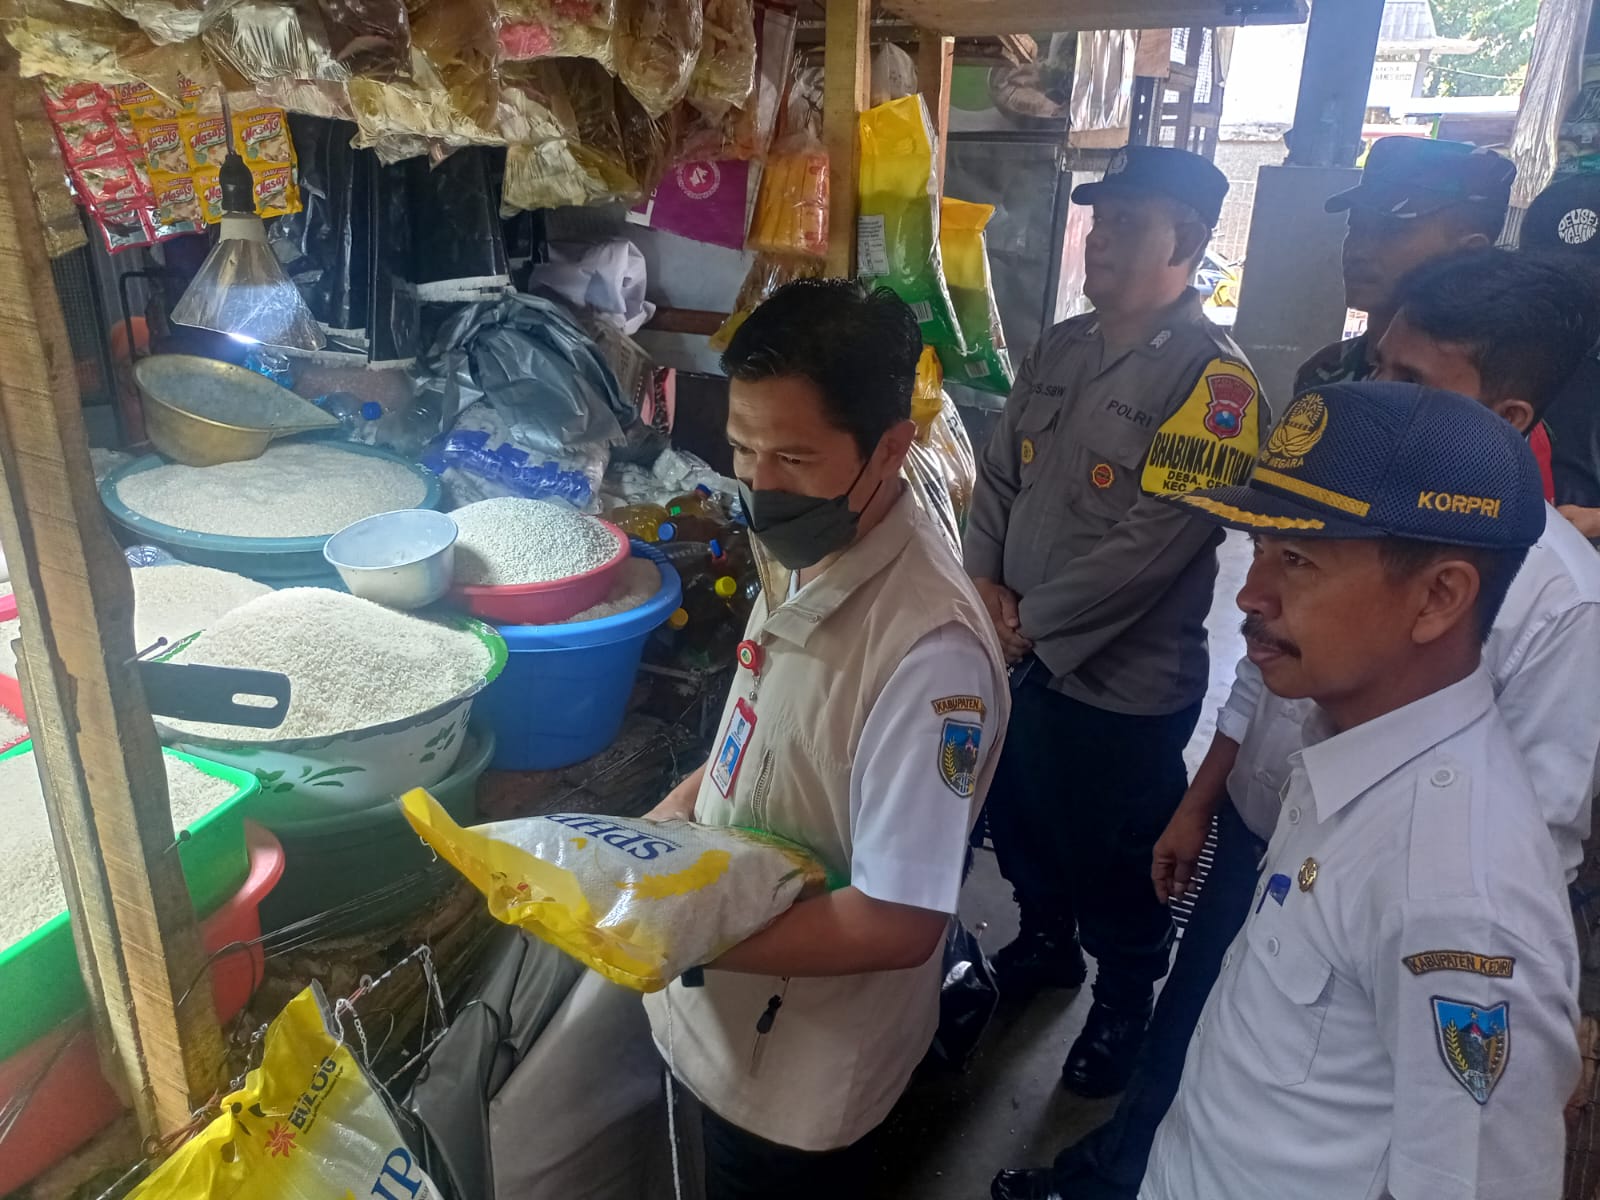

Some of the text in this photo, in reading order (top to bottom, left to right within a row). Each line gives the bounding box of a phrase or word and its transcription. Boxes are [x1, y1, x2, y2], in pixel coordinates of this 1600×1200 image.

[1106, 399, 1153, 428] POLRI
[1417, 490, 1501, 519] KORPRI
[934, 697, 980, 711] KABUPATEN
[1411, 952, 1476, 971] KABUPATEN
[287, 1055, 337, 1130] BULOG
